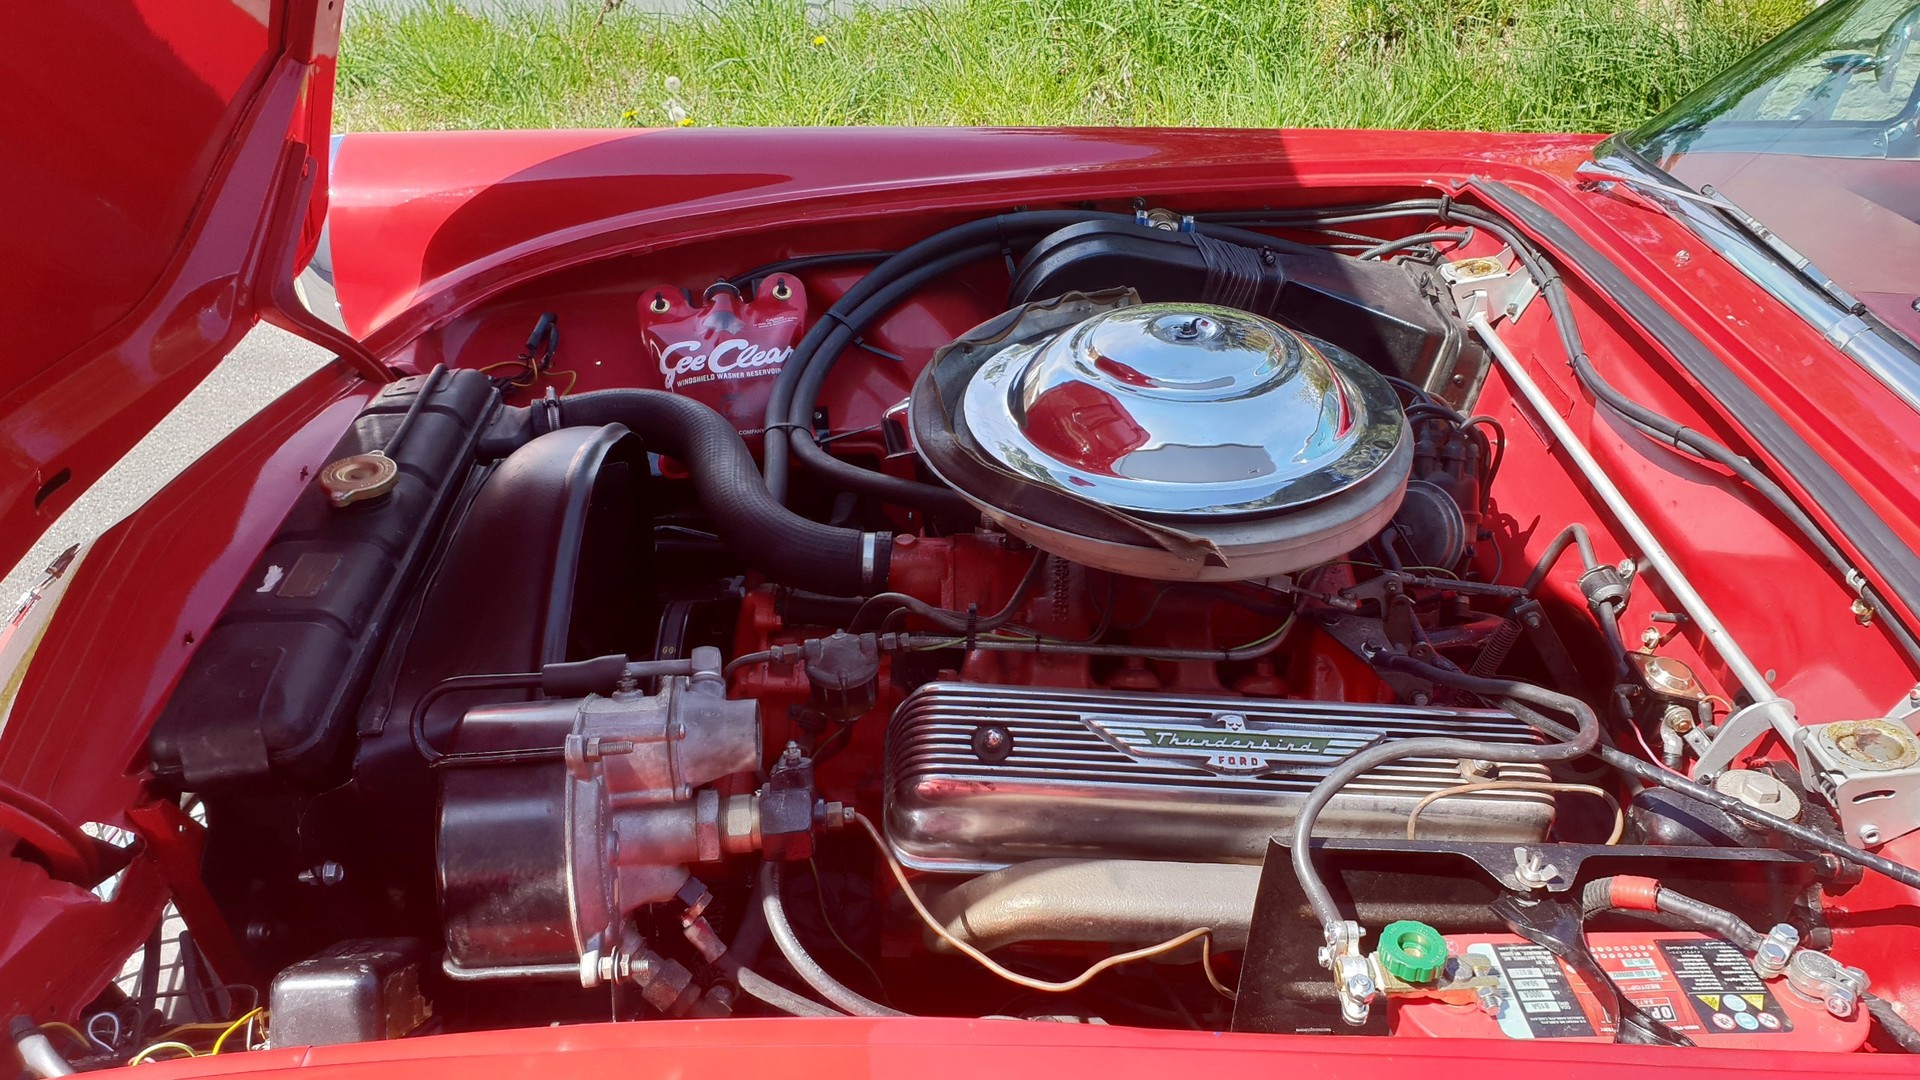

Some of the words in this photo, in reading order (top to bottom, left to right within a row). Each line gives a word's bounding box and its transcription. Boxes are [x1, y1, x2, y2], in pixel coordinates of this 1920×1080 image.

[676, 373, 716, 388] WINDSHIELD
[716, 369, 745, 380] WASHER
[1154, 731, 1319, 753] Thunderbird
[1218, 755, 1259, 767] FORD
